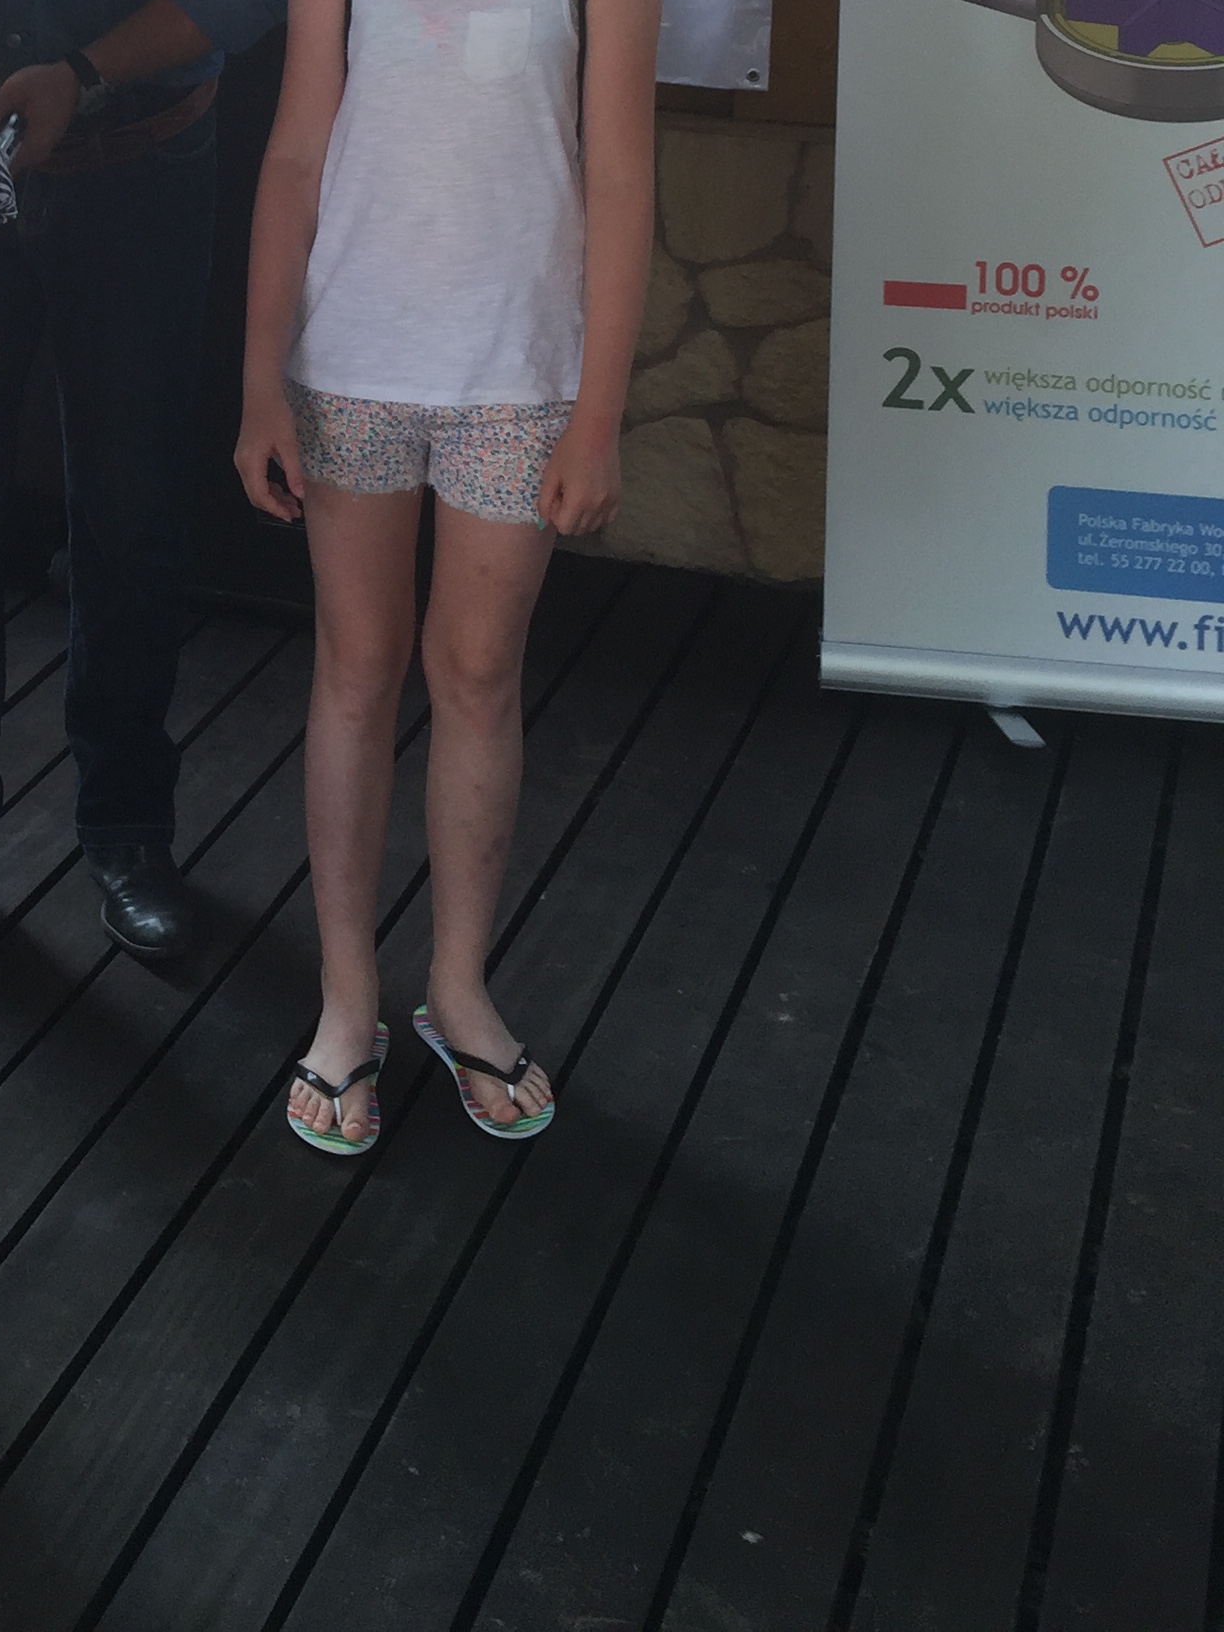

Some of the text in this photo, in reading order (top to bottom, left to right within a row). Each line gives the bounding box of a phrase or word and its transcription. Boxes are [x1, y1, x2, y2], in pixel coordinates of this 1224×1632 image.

[974, 261, 1099, 302] 100 %
[971, 299, 1099, 320] produkt polski
[882, 346, 976, 415] 2x
[984, 367, 1077, 392] większa
[1085, 373, 1211, 401] odporność
[983, 397, 1218, 432] większa odporność
[1078, 513, 1127, 531] Polska
[1131, 517, 1194, 537] Fabryka
[1078, 552, 1105, 566] tel.
[1111, 553, 1129, 569] 55
[1133, 556, 1162, 571] 277
[1167, 559, 1185, 574] 22
